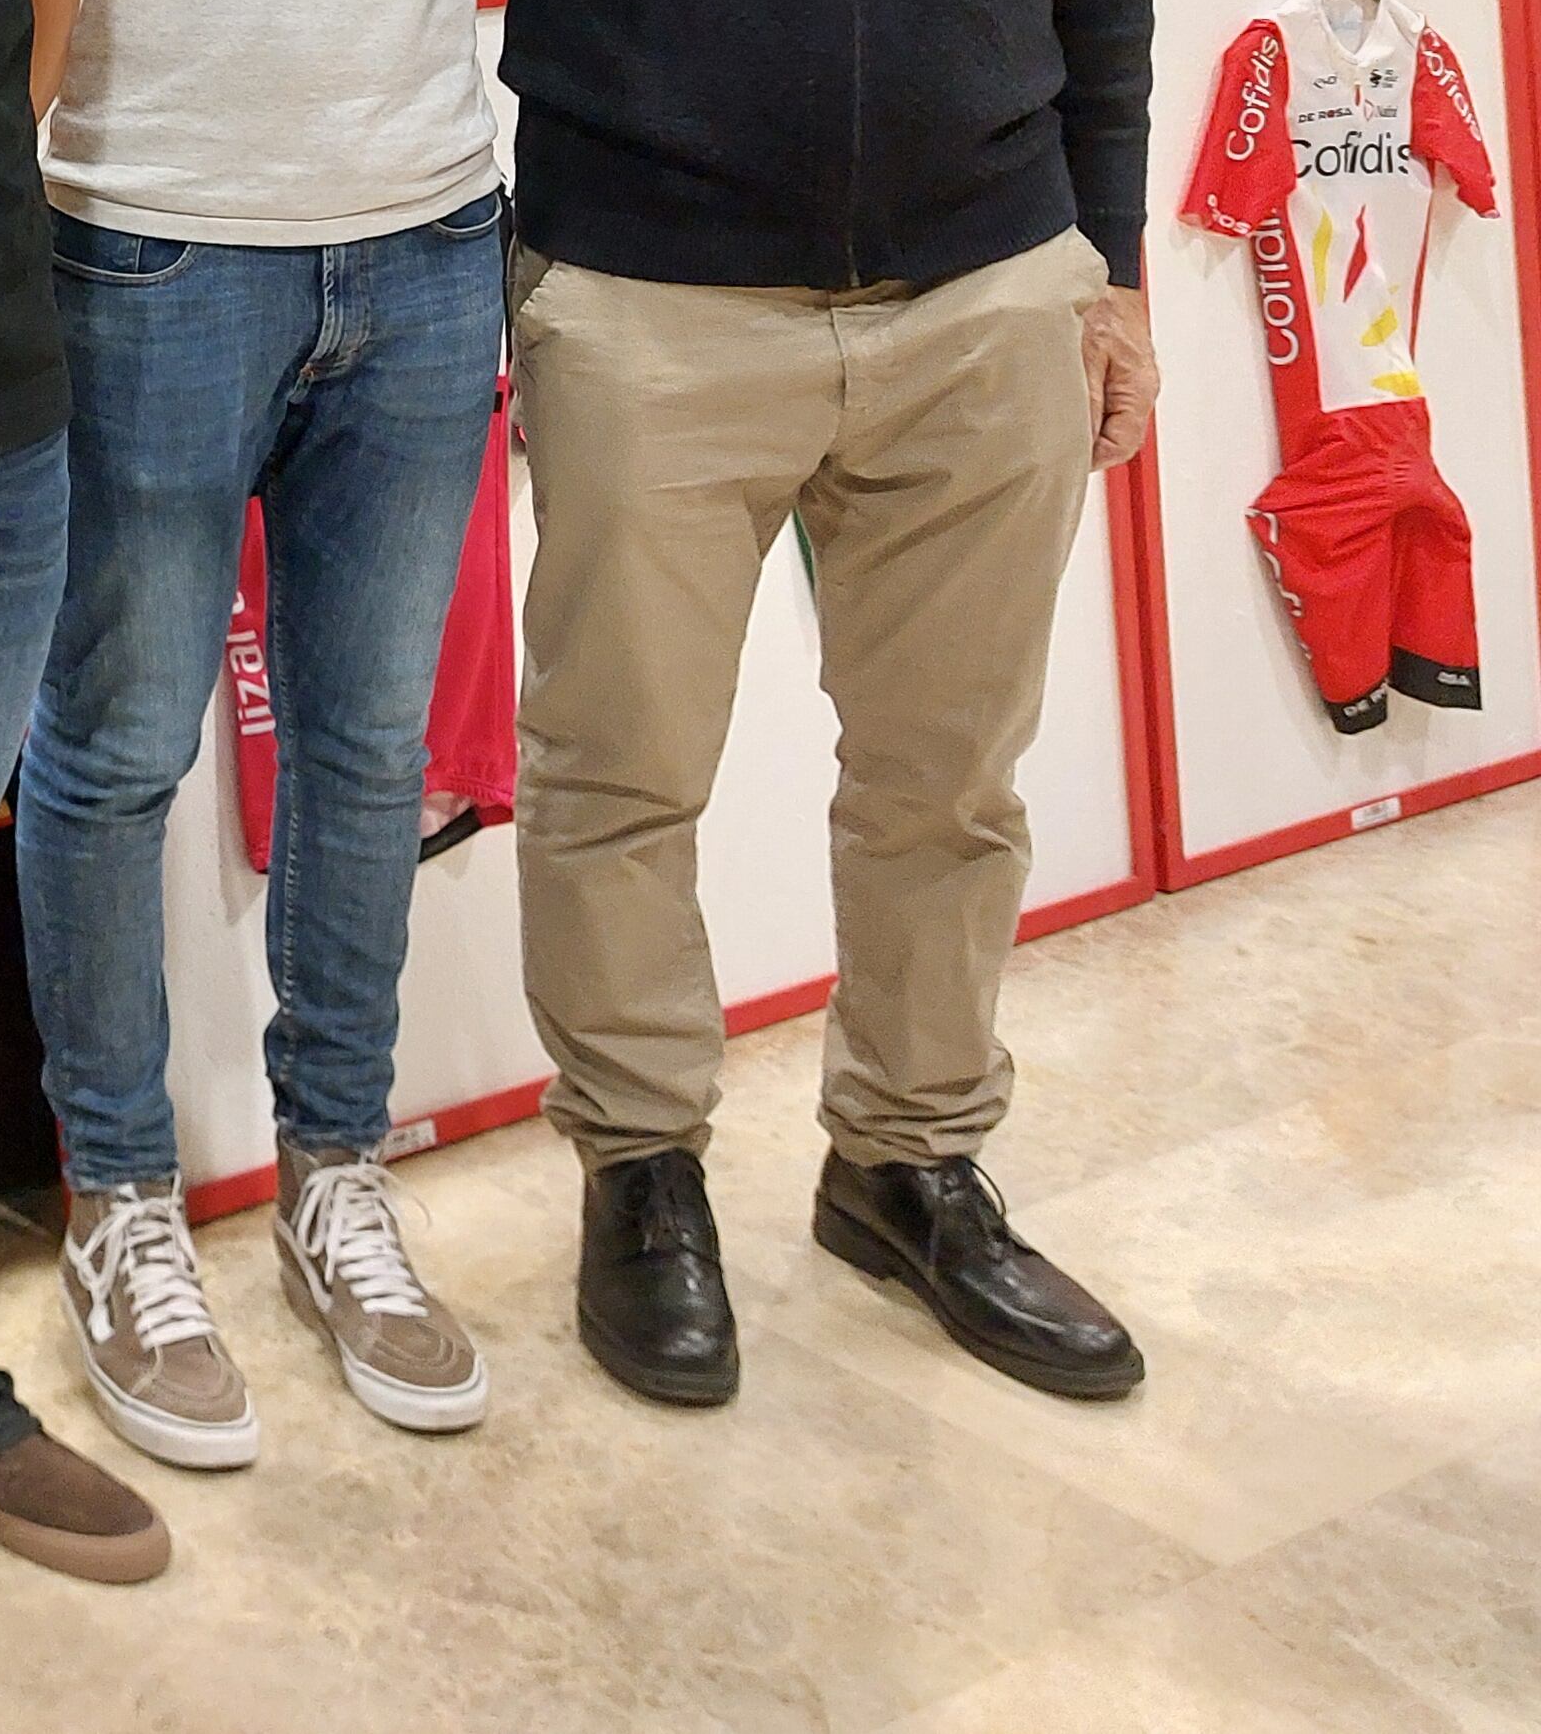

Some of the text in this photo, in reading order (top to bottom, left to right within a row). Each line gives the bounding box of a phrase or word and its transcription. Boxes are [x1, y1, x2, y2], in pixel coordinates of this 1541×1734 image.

[1224, 35, 1281, 161] Cofidis
[1291, 131, 1412, 178] Cofidis
[1254, 210, 1299, 366] Cofidi
